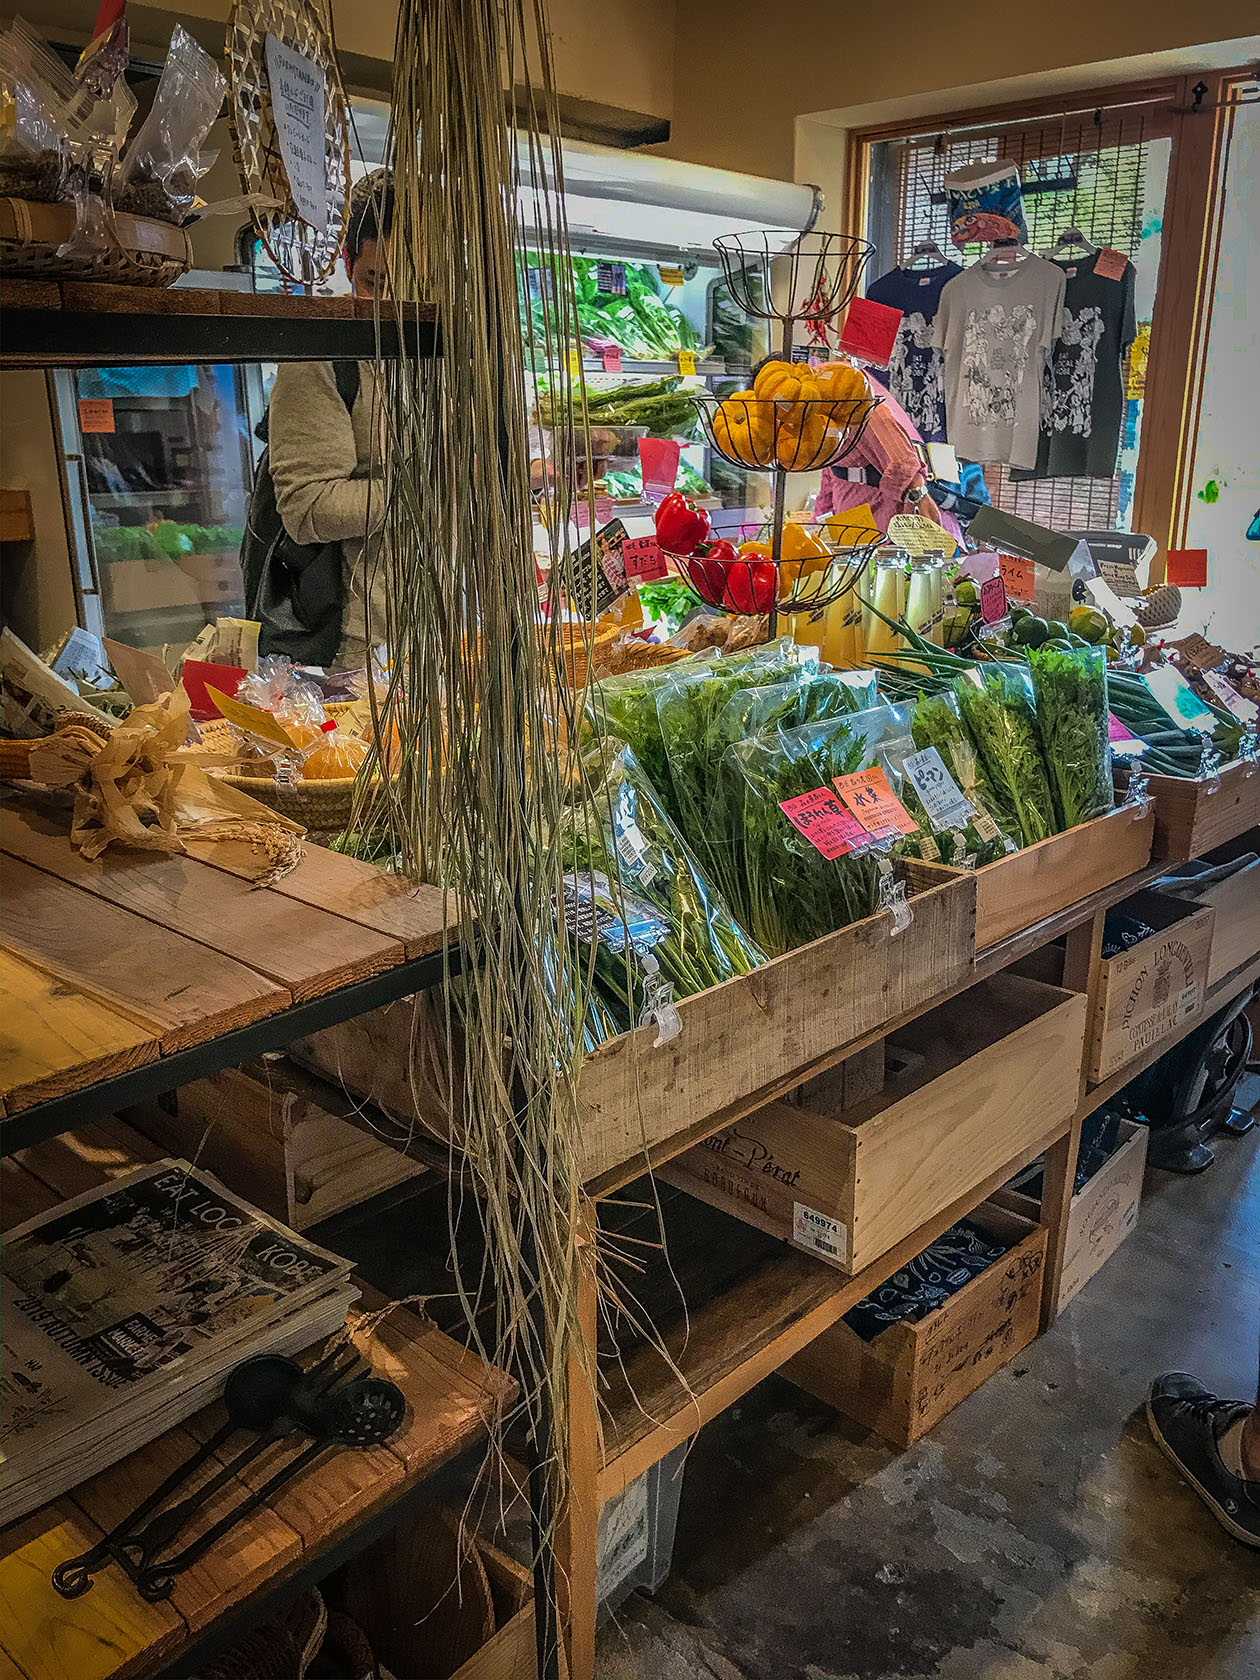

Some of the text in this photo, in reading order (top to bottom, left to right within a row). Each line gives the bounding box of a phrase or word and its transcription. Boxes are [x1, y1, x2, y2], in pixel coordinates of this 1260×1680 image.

[629, 555, 657, 569] すだち
[1001, 564, 1024, 579] ライム
[913, 766, 944, 790] ピーマン
[853, 786, 884, 807] 水菜
[793, 798, 844, 829] ほうれん草
[154, 1174, 200, 1202] EAT
[803, 1211, 838, 1233] 649974
